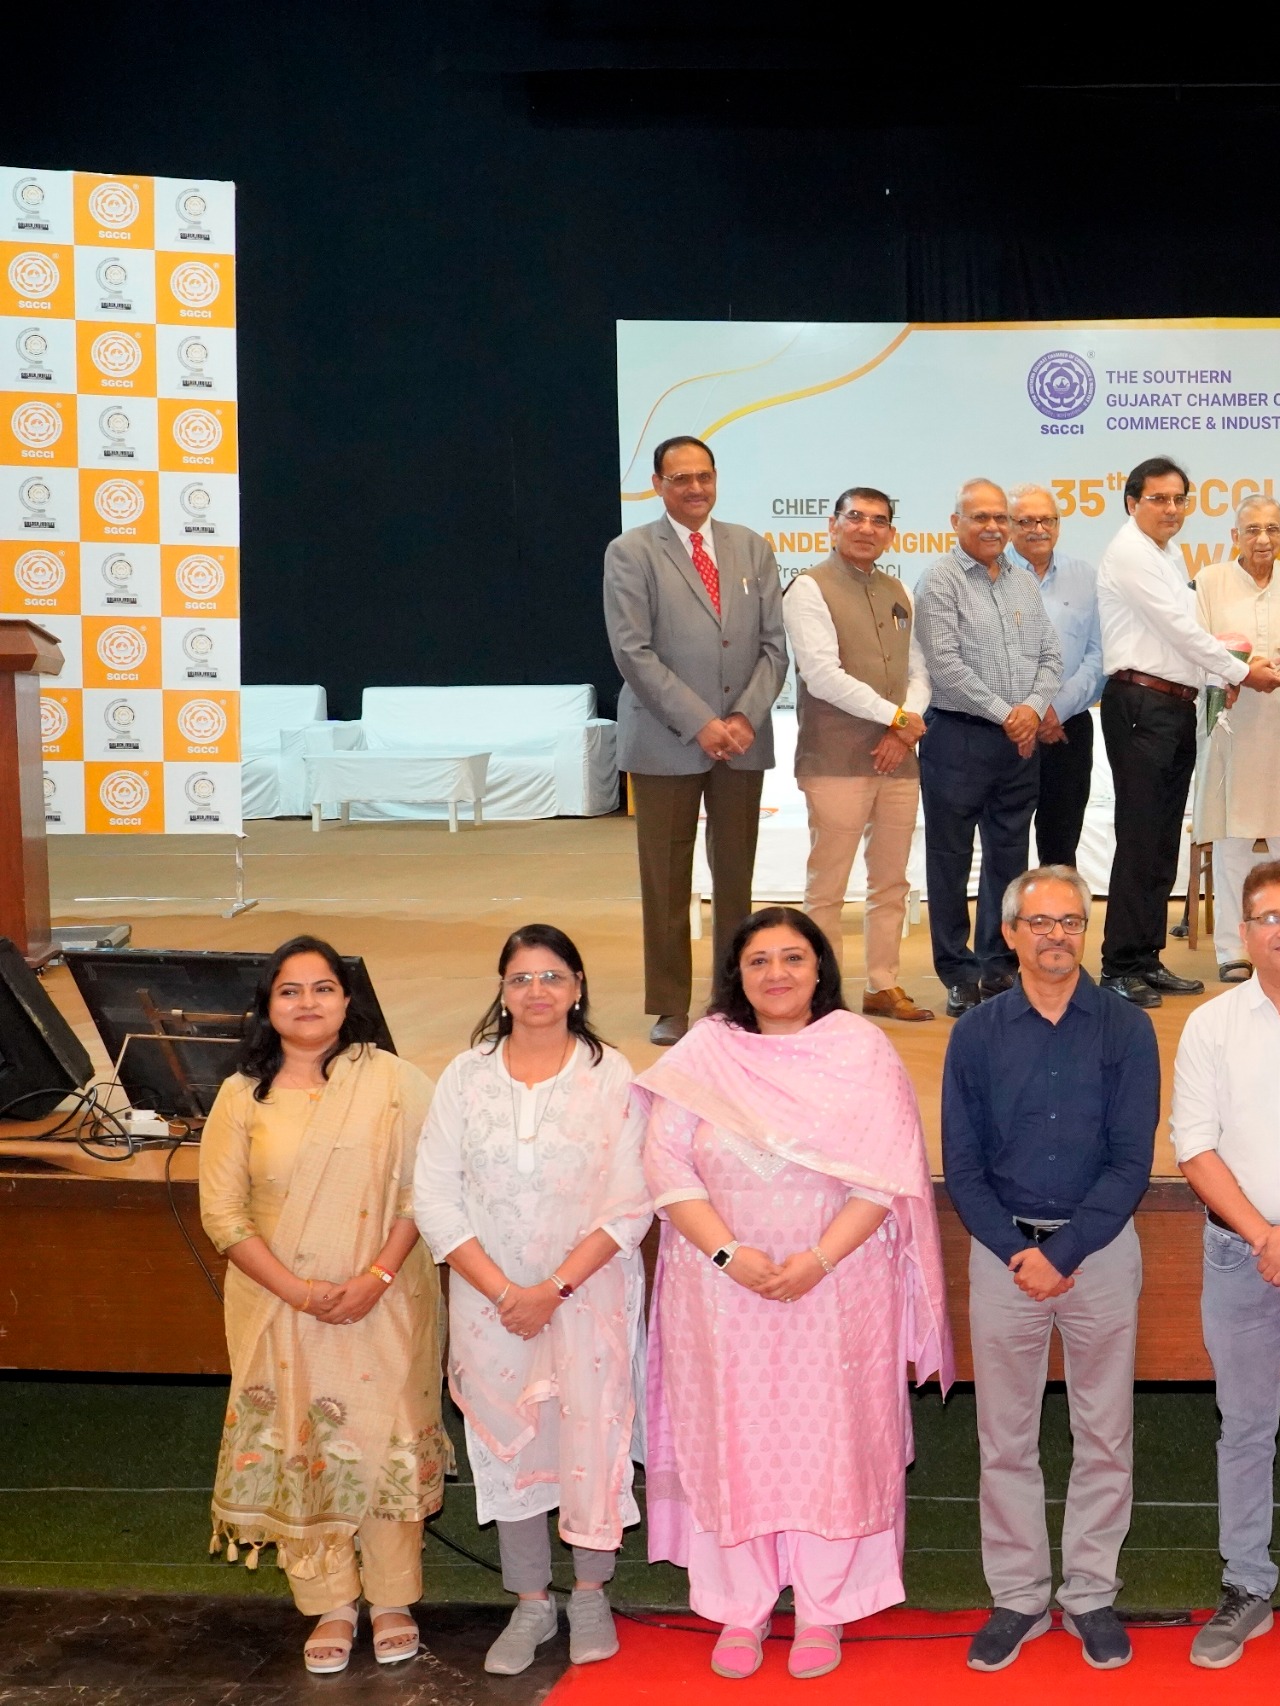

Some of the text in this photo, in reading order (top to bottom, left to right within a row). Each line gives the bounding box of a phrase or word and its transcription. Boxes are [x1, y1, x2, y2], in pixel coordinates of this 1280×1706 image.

[98, 230, 131, 240] SGCCI
[18, 300, 51, 310] SGCCI
[179, 309, 211, 319] SGCCI
[1105, 370, 1232, 384] THE SOUTHERN
[101, 378, 133, 388] SGCCI
[1106, 393, 1182, 407] GUJARAT
[1186, 393, 1268, 407] CHAMBER
[1106, 416, 1202, 430] COMMERCE
[1206, 416, 1217, 430] &
[1040, 424, 1085, 435] SGCCI
[21, 449, 54, 459] SGCCI
[182, 456, 214, 466] SGCCI
[772, 498, 830, 515] CHIEF
[104, 526, 136, 536] SGCCI
[24, 597, 57, 607] SGCCI
[185, 601, 216, 610] SGCCI
[106, 671, 139, 682] SGCCI
[42, 745, 60, 753] CCI
[187, 745, 219, 754] SGCCI
[109, 816, 142, 827] SGCCI
